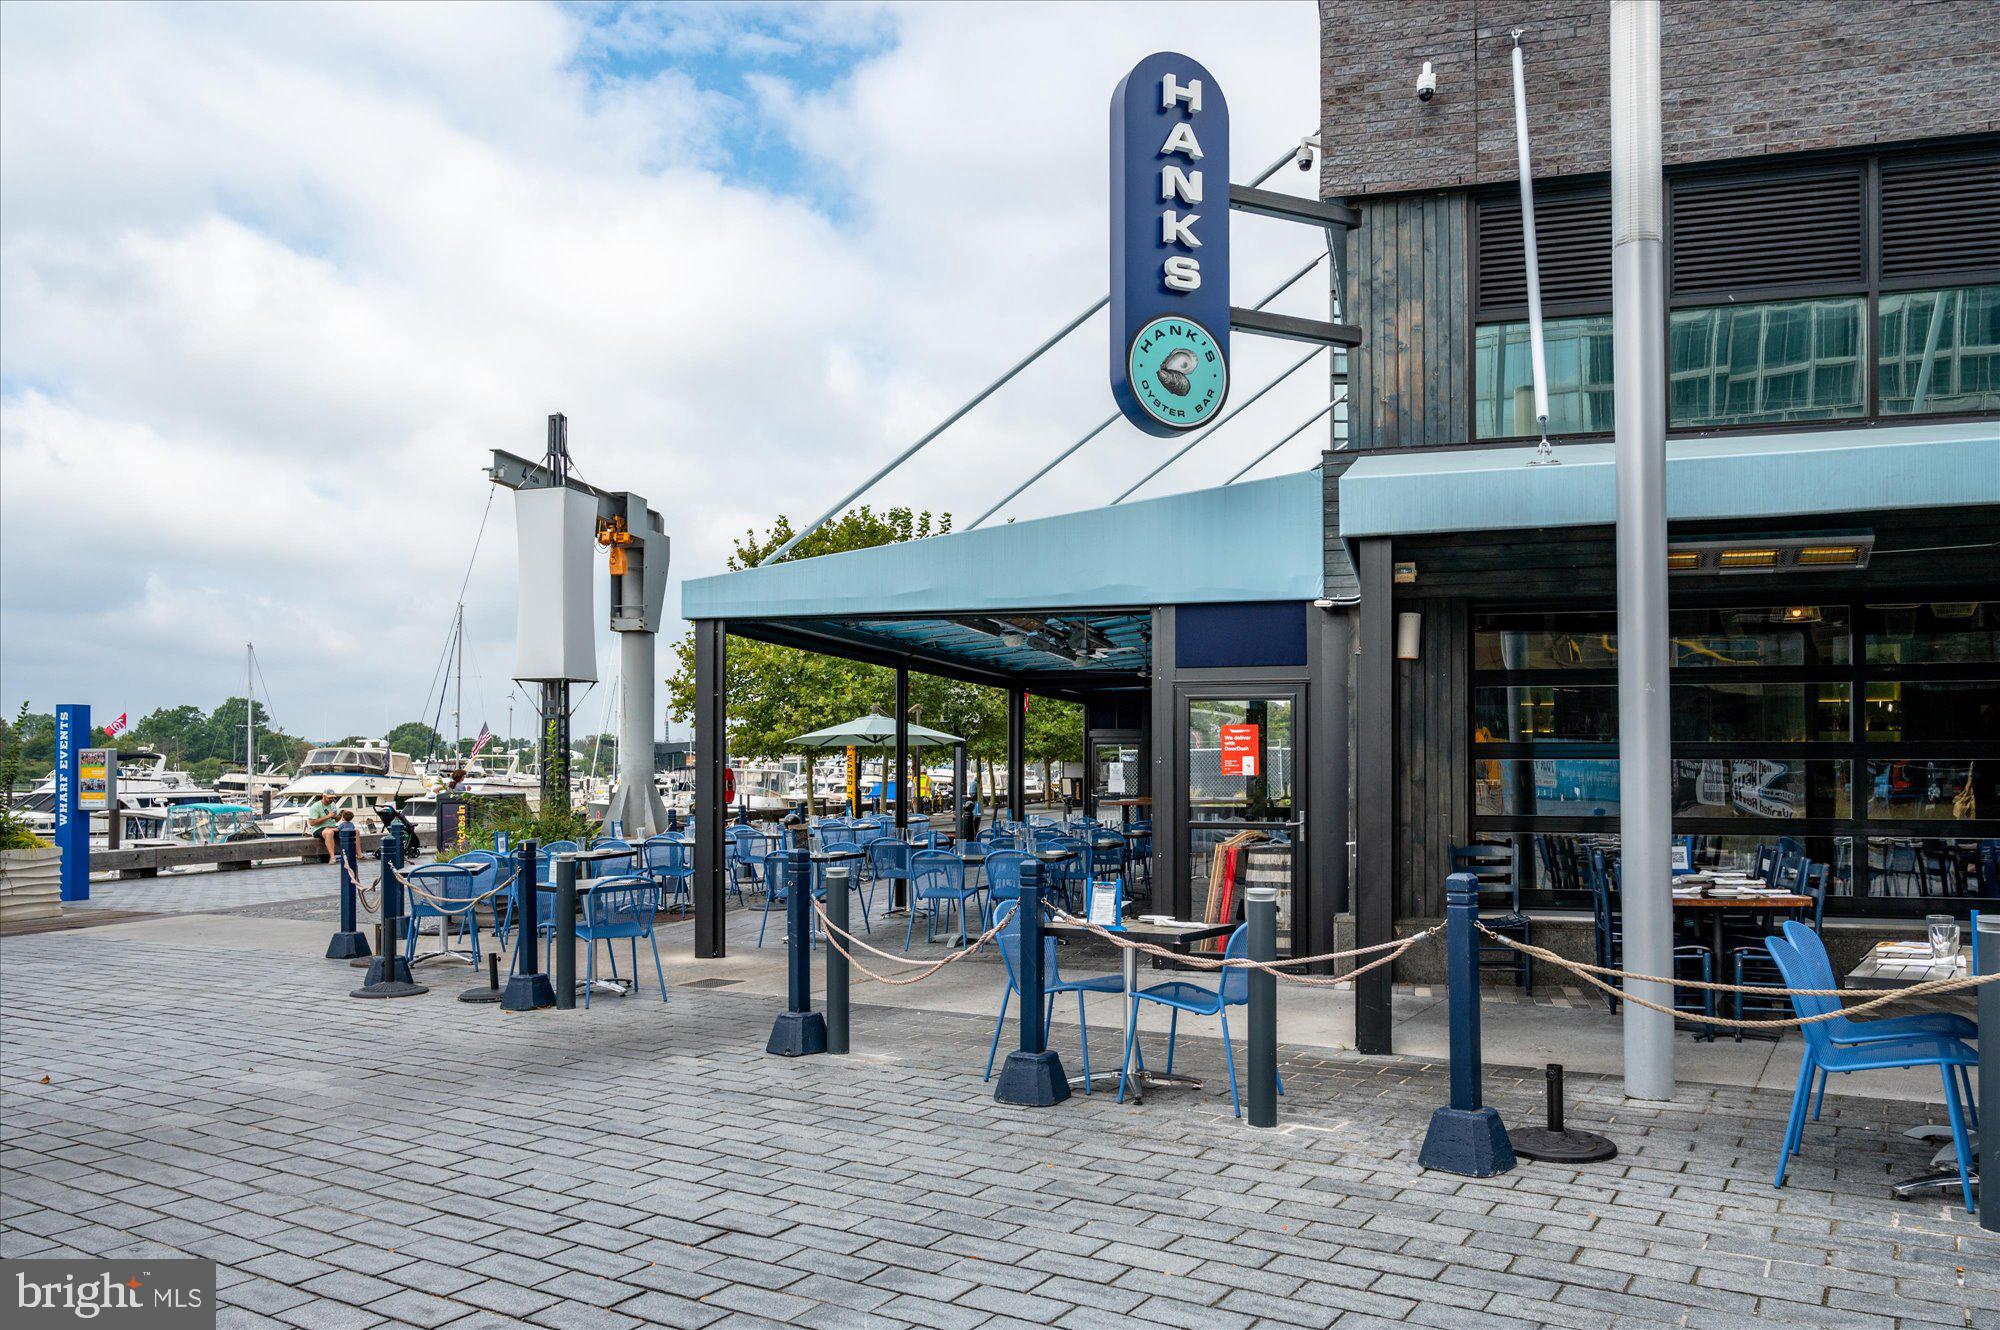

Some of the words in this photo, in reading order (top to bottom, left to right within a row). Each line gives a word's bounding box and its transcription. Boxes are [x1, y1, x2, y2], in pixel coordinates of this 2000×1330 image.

[1160, 72, 1205, 292] HANKS
[1140, 324, 1216, 364] HANK'S
[1141, 379, 1186, 418] OYSTER
[1195, 388, 1216, 415] BAR
[59, 711, 69, 770] EVENTS
[59, 773, 68, 827] WHARF
